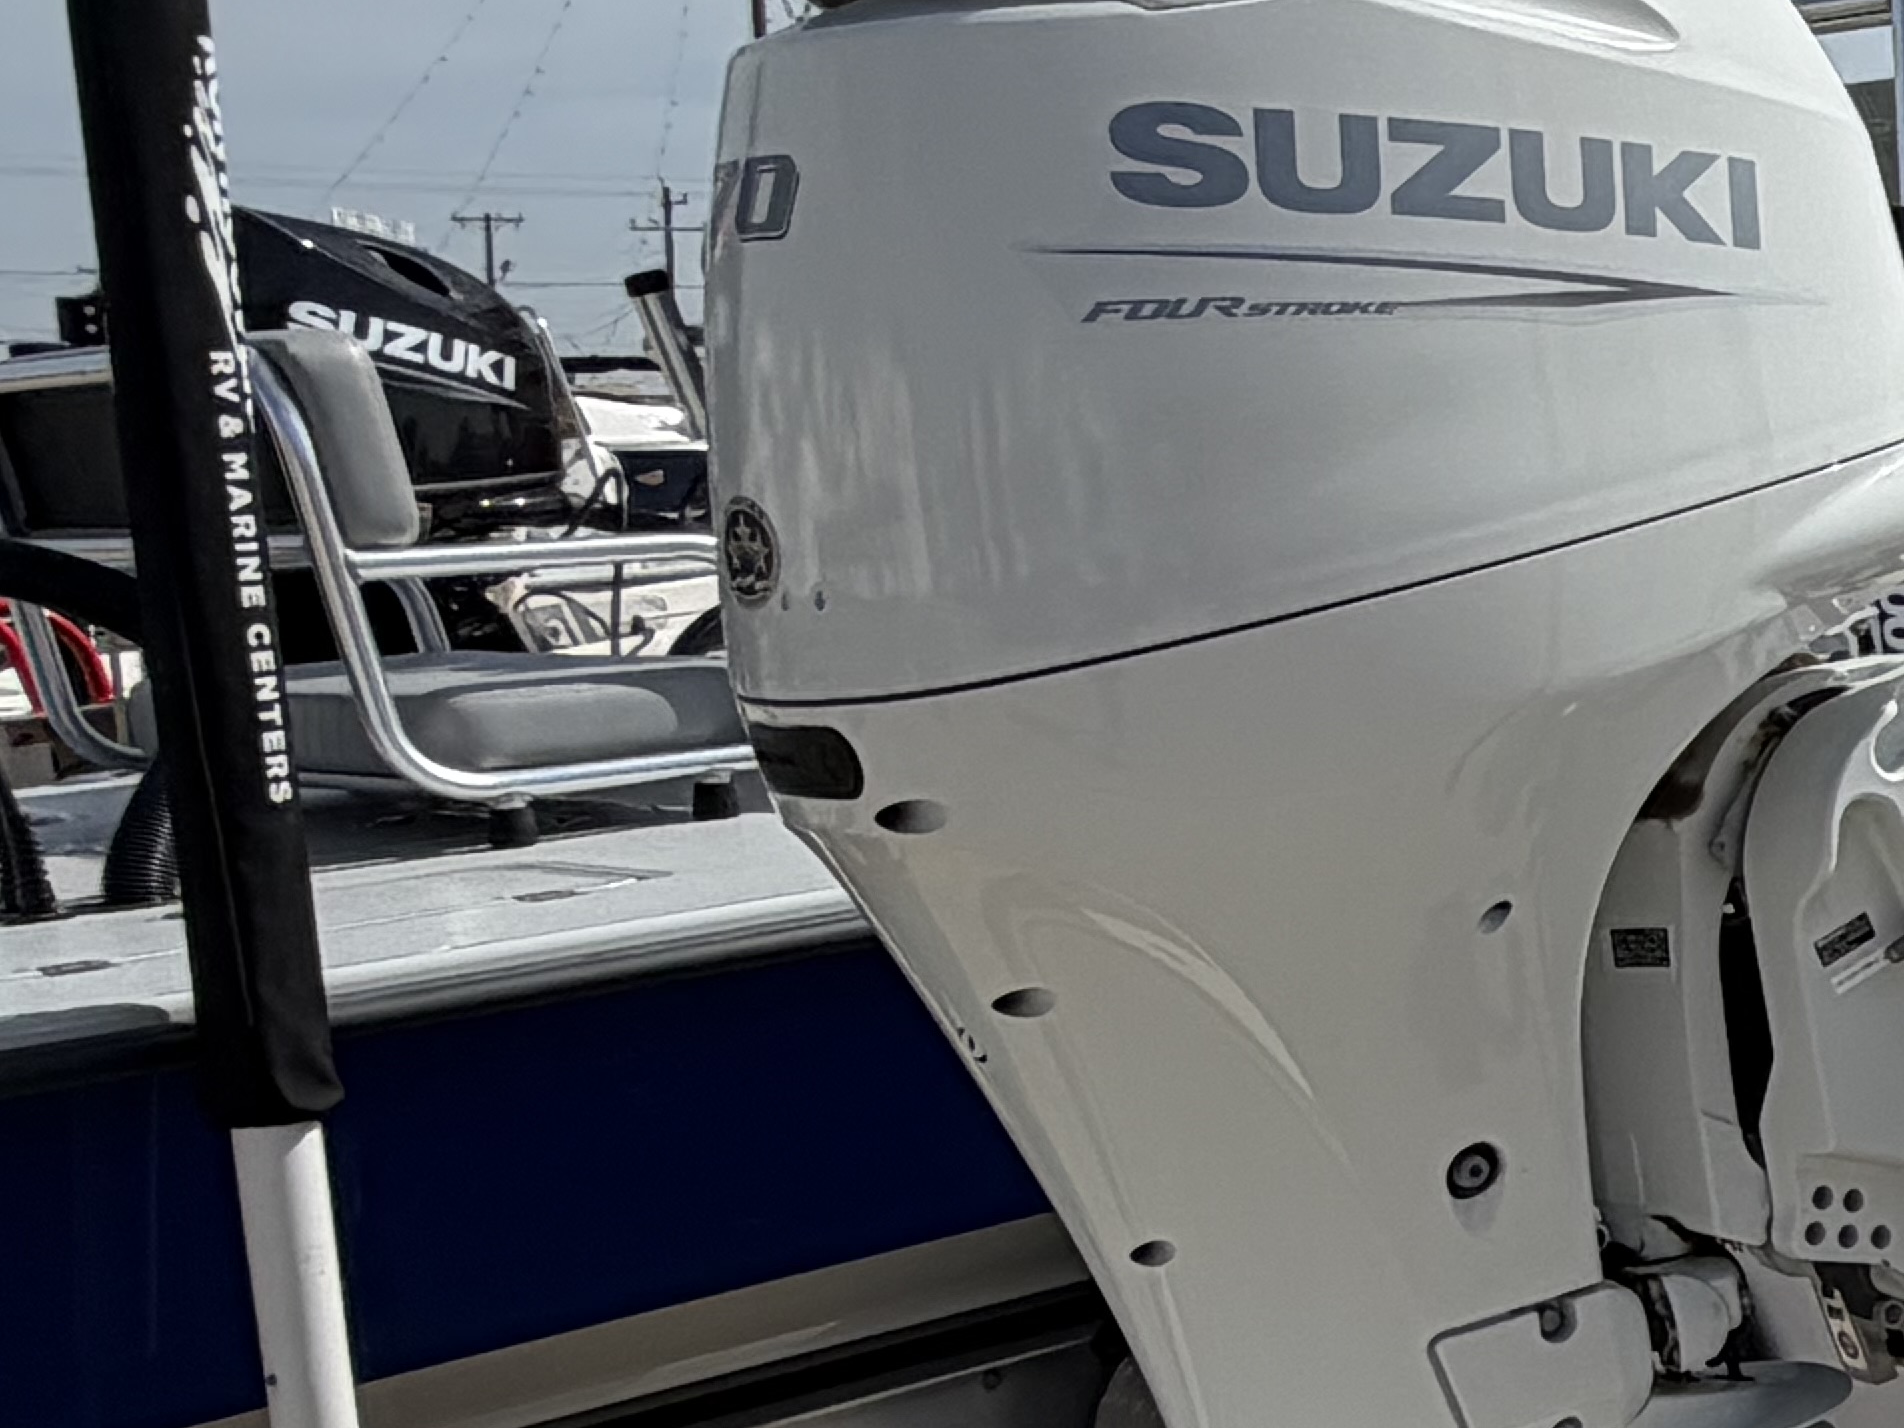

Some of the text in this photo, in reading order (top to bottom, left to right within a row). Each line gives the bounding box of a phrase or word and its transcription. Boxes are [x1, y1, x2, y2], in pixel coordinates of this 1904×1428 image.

[1108, 101, 1761, 250] SUZUKI
[209, 350, 242, 403] RV
[288, 301, 516, 391] SUZUKI
[219, 415, 244, 440] &
[221, 452, 266, 609] MARINE
[246, 623, 293, 805] CENTERS
